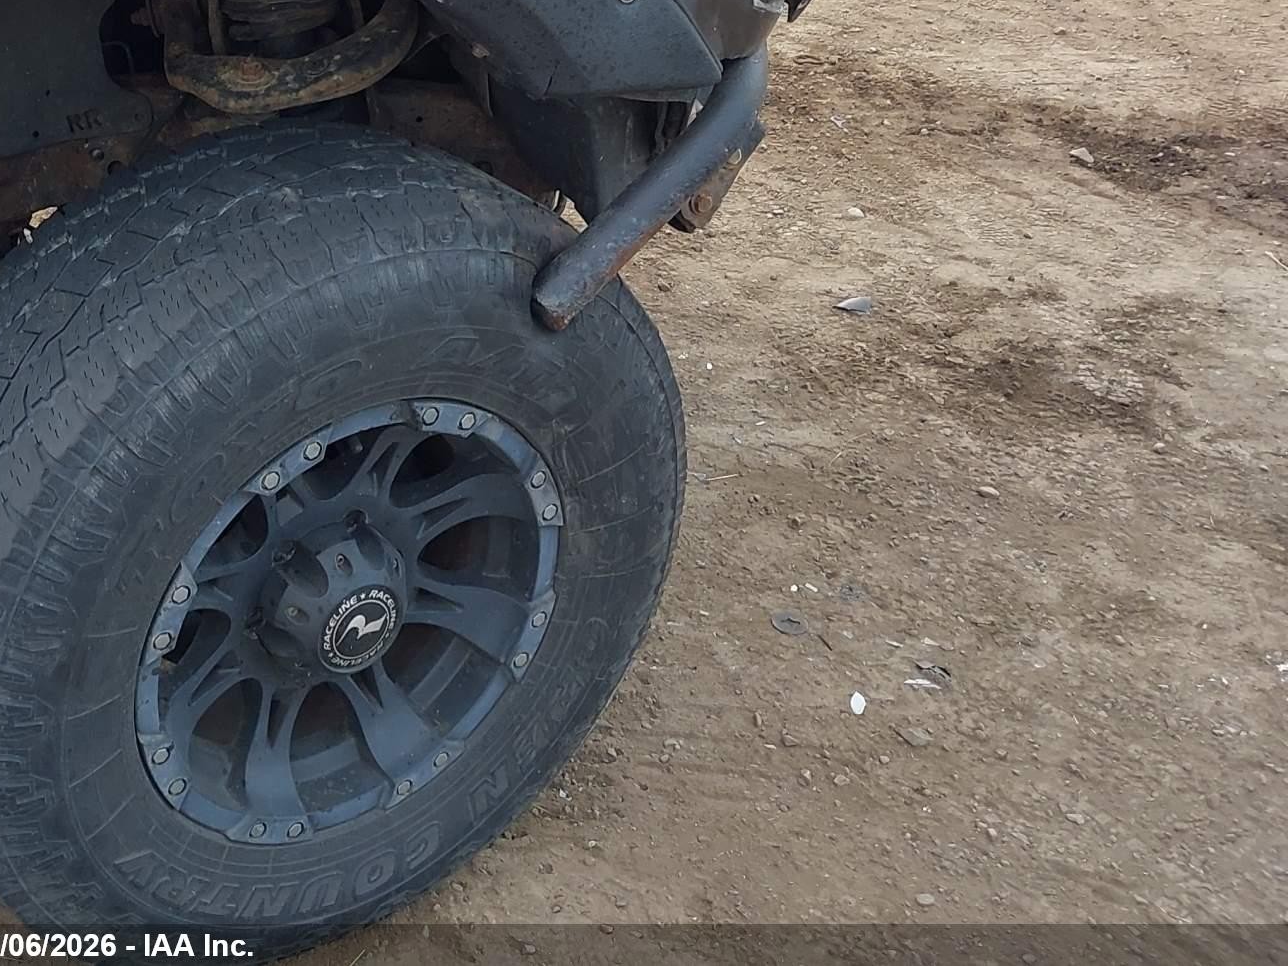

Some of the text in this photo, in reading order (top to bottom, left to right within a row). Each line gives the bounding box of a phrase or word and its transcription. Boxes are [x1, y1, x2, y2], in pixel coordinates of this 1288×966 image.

[323, 594, 358, 651] RACELINE
[368, 589, 397, 631] RACELINE
[113, 821, 441, 919] COUNTRY
